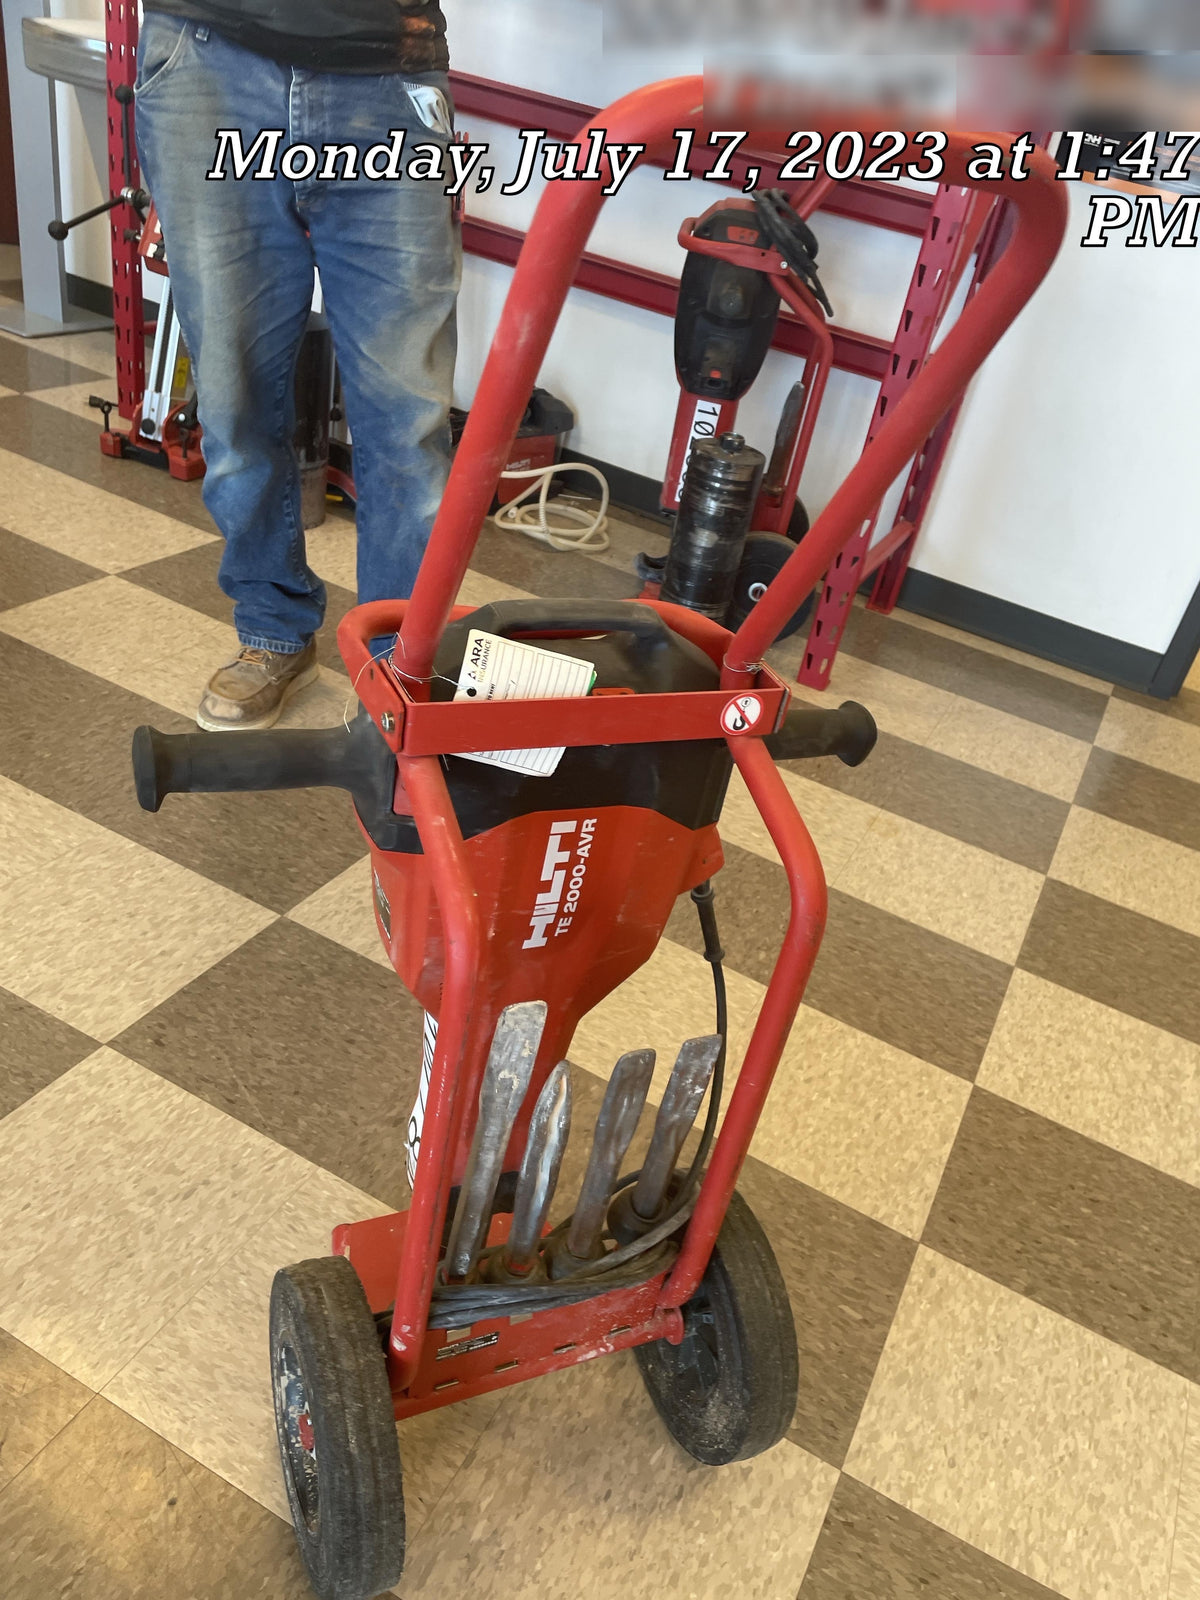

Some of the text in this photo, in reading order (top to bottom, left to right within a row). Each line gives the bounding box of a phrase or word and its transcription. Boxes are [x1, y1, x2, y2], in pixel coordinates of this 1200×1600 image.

[470, 638, 484, 667] ARA
[522, 820, 577, 949] HILTI
[554, 818, 598, 936] TE 2000-AVR
